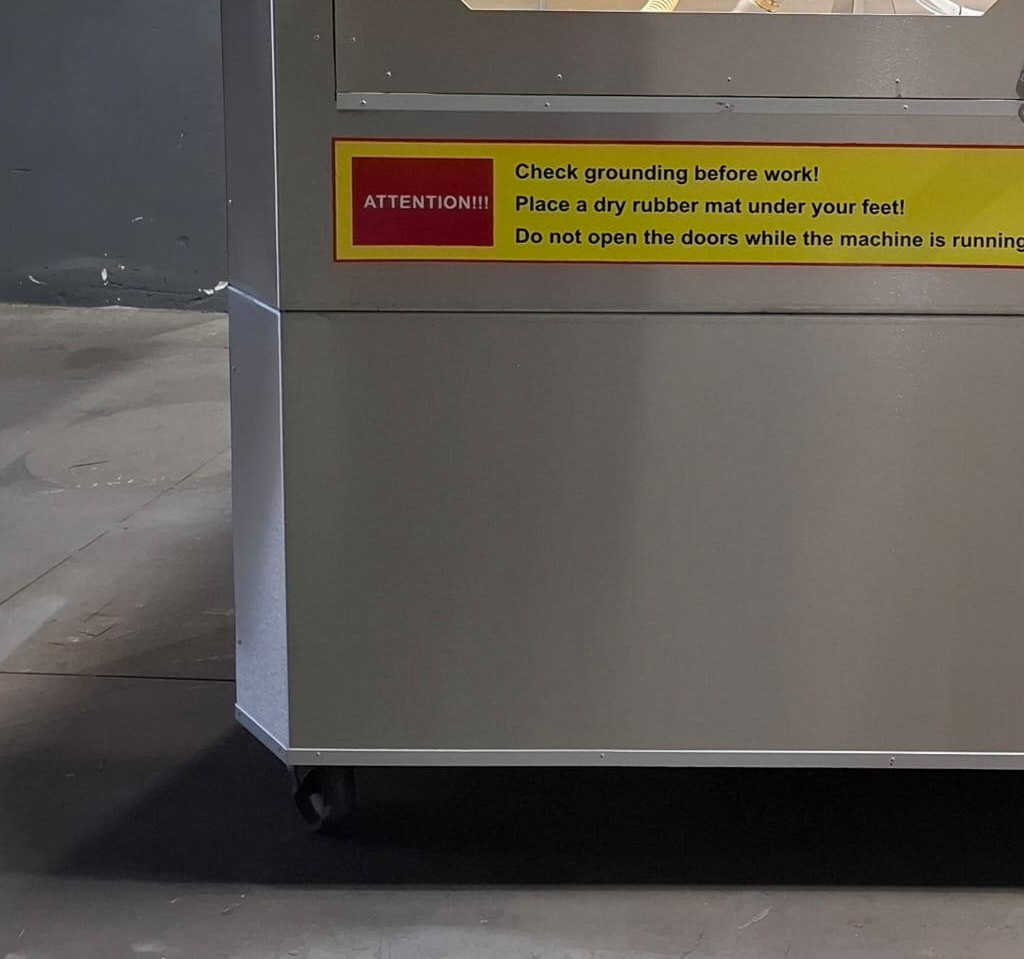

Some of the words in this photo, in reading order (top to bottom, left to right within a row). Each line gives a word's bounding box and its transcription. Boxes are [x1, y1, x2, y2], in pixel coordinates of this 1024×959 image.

[515, 163, 578, 180] Check
[585, 164, 688, 184] grounding
[695, 165, 758, 181] before
[764, 166, 819, 182] work!
[363, 194, 489, 210] ATTENTION!!!
[515, 196, 571, 212] Place
[577, 200, 588, 212] a
[594, 197, 626, 216] dry
[633, 197, 698, 213] rubber
[705, 199, 742, 213] mat
[748, 199, 804, 214] under
[811, 202, 857, 218] your
[862, 199, 905, 215] feet!
[515, 228, 543, 244] Do
[549, 230, 582, 244] not
[588, 232, 637, 248] open
[643, 229, 675, 245] the
[681, 229, 739, 245] doors
[745, 230, 797, 246] while
[803, 231, 833, 246] the
[840, 231, 924, 247] machine
[930, 232, 946, 247] is
